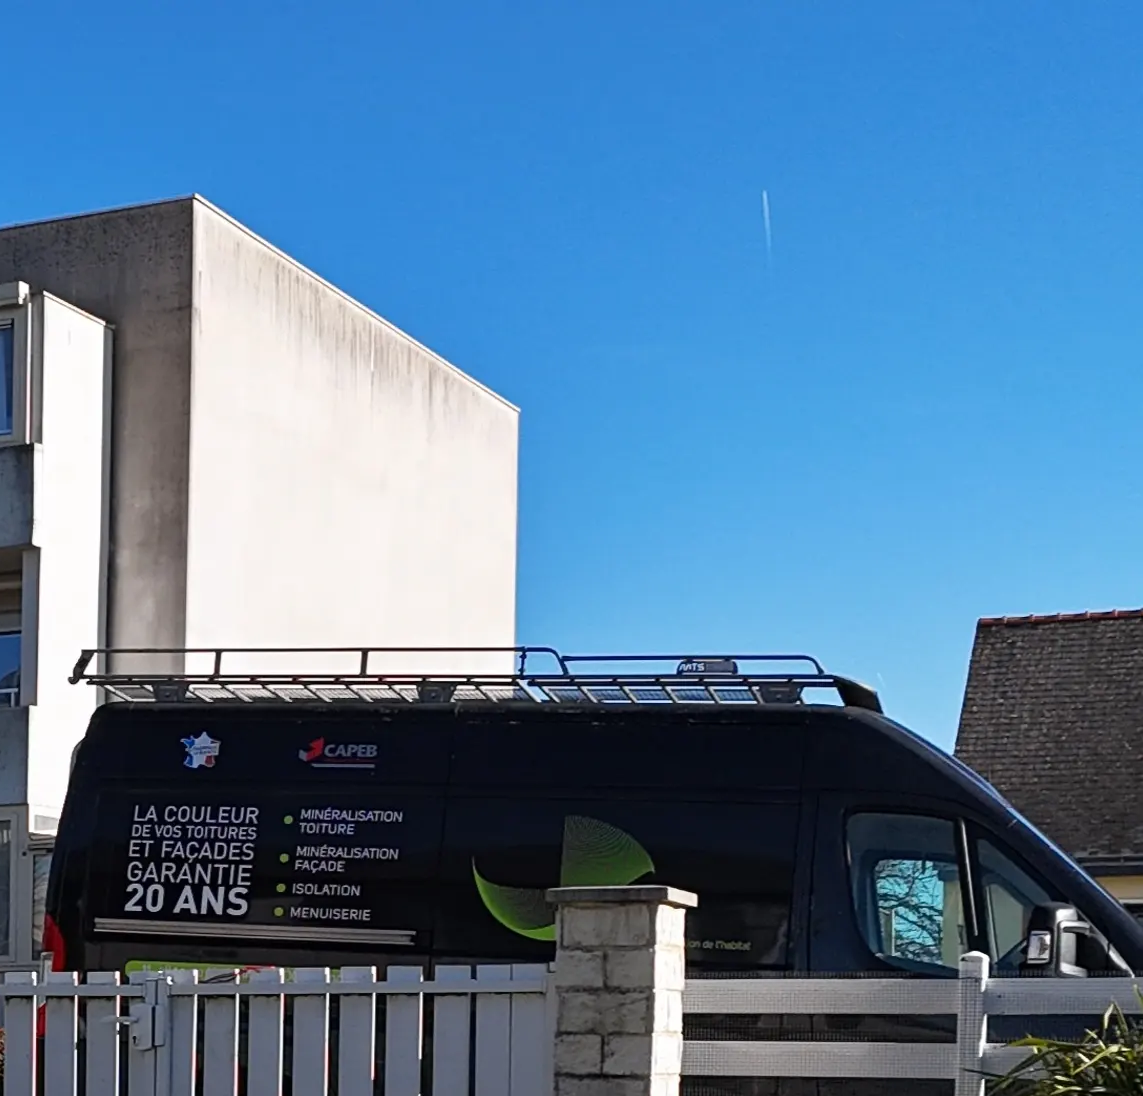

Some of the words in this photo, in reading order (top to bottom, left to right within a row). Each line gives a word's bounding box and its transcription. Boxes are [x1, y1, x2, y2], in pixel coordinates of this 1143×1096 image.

[324, 744, 378, 758] CAPEB
[133, 805, 158, 821] LA
[164, 805, 259, 824] COULEUR
[300, 807, 403, 822] MINÉRALISATION
[131, 824, 152, 837] DE
[155, 825, 182, 838] VOS
[186, 826, 257, 840] TOITURES
[299, 822, 355, 835] TOITURE
[128, 839, 154, 858] ET
[160, 841, 255, 863] FAÇADES
[296, 844, 399, 860] MINÉRALISATION
[126, 861, 253, 886] GARANTIE
[294, 860, 346, 873] FAÇADE
[292, 883, 361, 896] ISOLATION
[123, 883, 165, 913] 20
[172, 885, 248, 916] ANS
[290, 907, 371, 921] MENUISERIE
